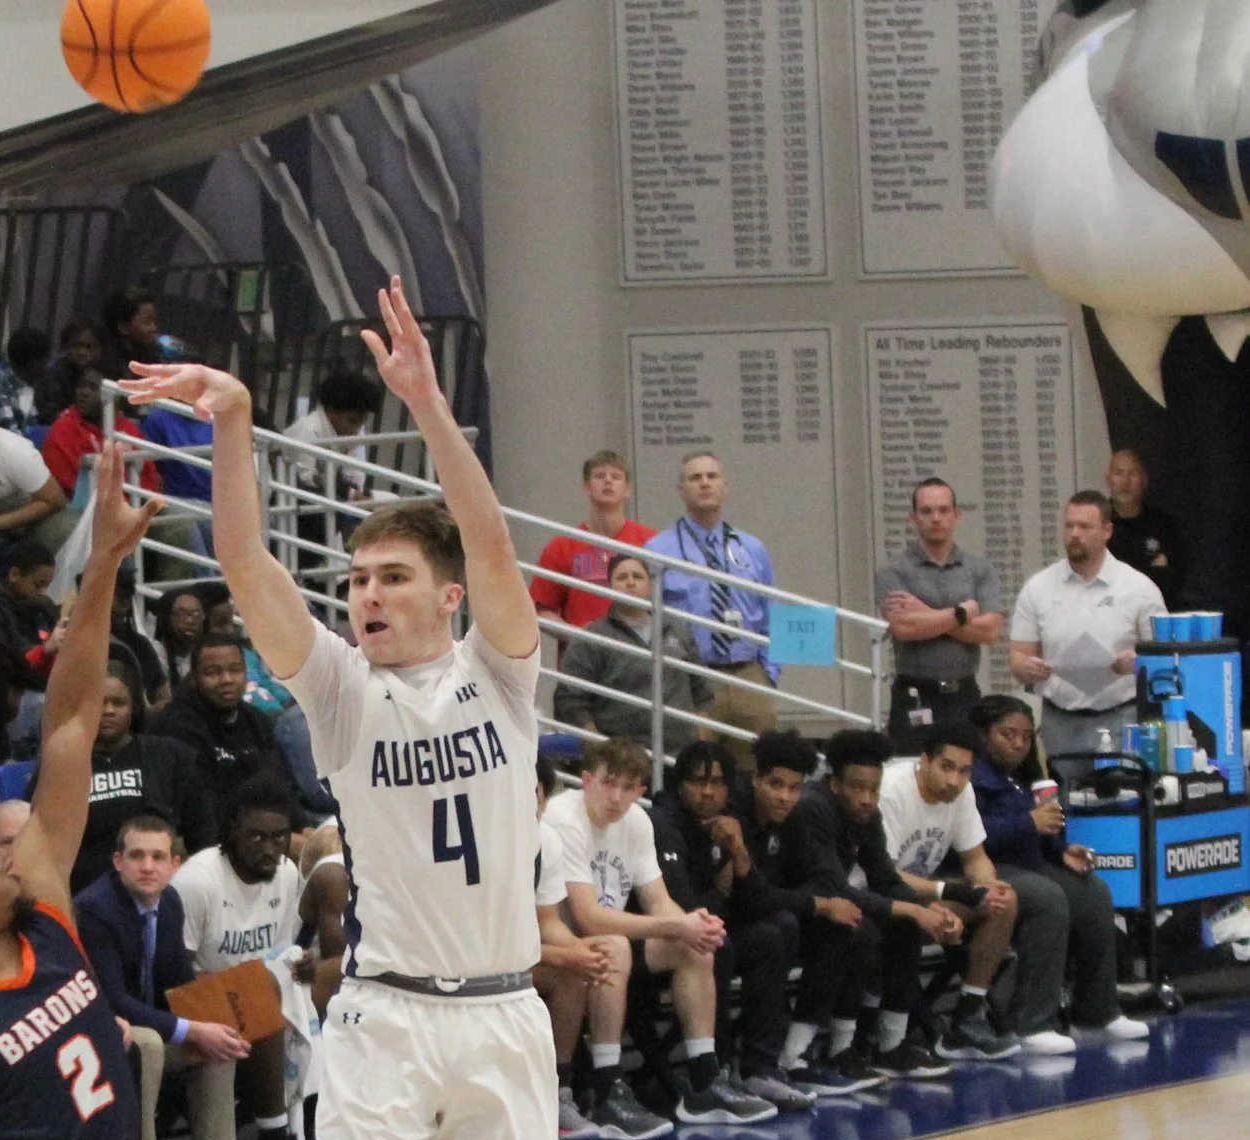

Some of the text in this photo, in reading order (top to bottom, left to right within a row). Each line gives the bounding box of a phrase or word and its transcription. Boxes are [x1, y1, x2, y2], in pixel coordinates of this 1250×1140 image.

[876, 335, 1062, 352] All Time Leading Rebounders
[787, 620, 817, 633] EXIT
[371, 720, 507, 788] AUGUSTA
[432, 793, 480, 886] 4
[1166, 838, 1240, 874] POWERADE
[56, 1032, 117, 1124] 2
